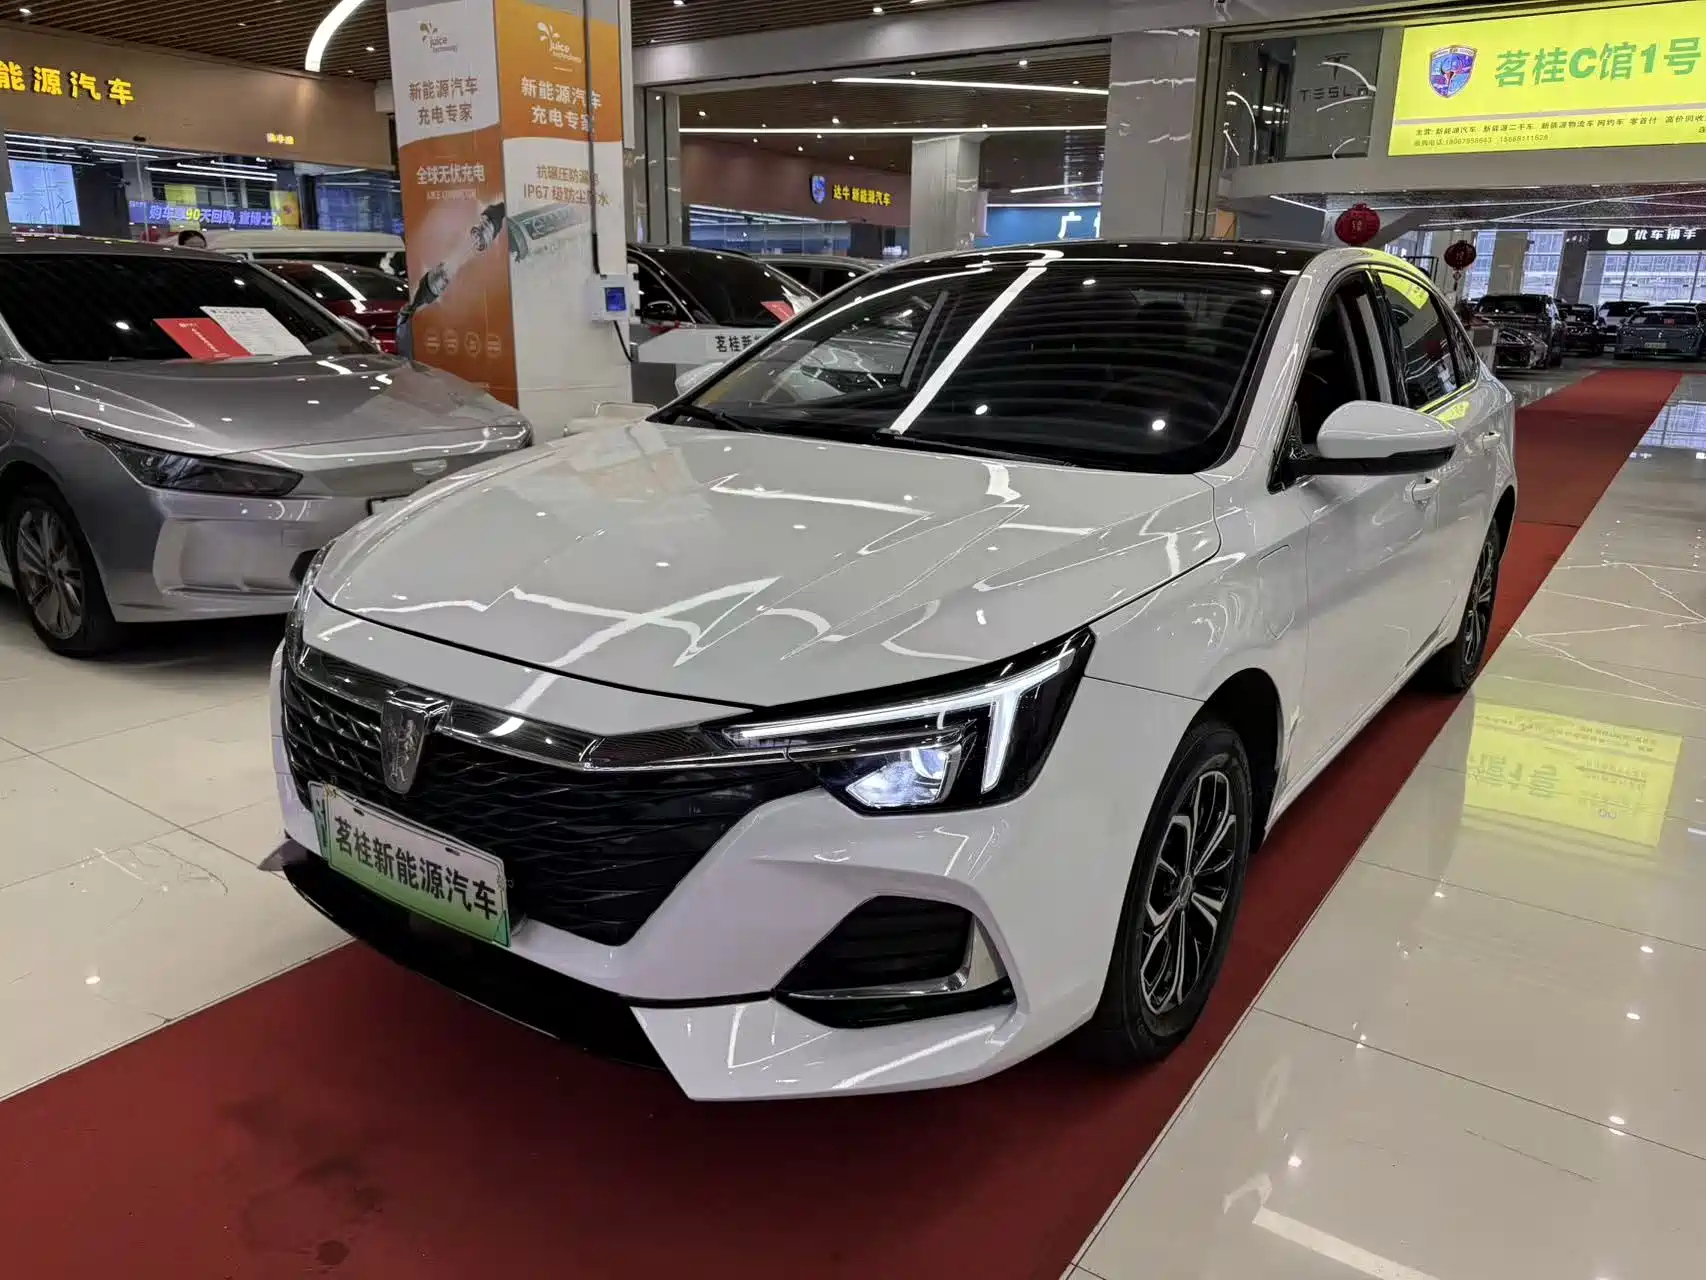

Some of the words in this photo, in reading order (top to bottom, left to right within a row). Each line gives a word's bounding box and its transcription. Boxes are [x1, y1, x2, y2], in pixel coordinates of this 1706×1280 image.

[1494, 36, 1702, 88] 茗桂C馆1号
[0, 60, 134, 105] 能源汽车
[408, 76, 478, 102] 新能源汽车
[521, 76, 602, 109] 新能源汽车
[417, 103, 472, 126] 充电专家
[523, 184, 550, 199] IP67
[333, 816, 499, 920] 茗桂新能源汽车
